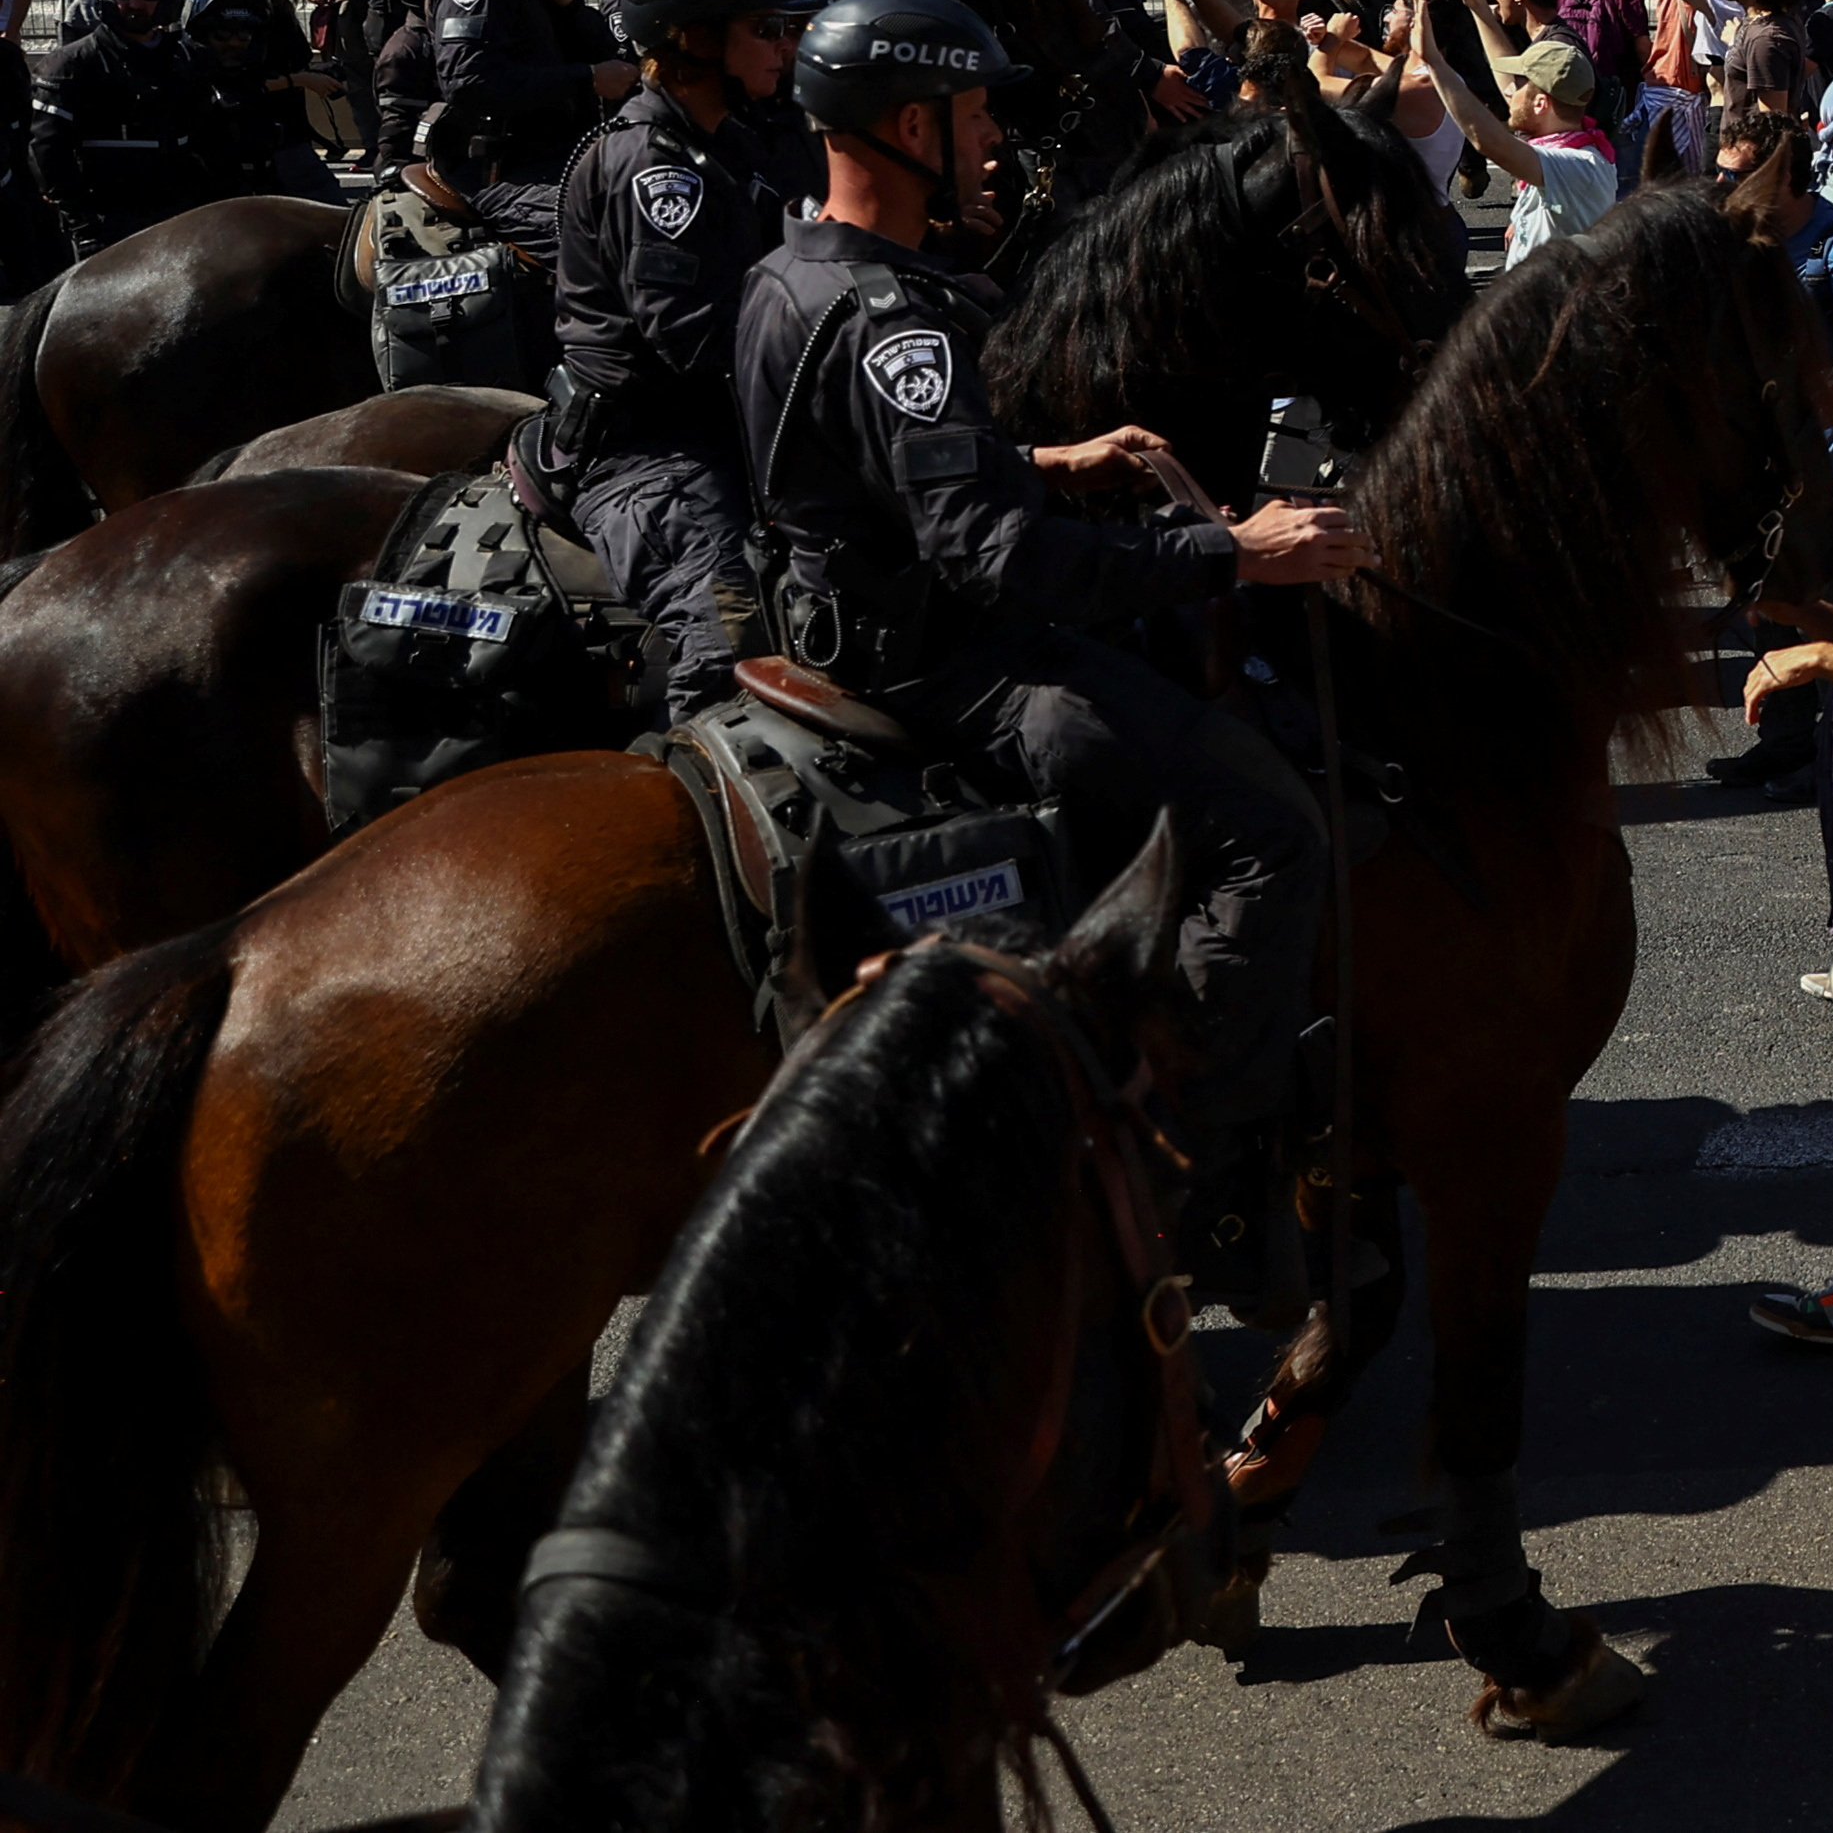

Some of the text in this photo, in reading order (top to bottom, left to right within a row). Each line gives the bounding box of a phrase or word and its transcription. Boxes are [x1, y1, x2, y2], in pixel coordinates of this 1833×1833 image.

[869, 38, 981, 71] POLICE
[395, 273, 481, 302] משטרה
[871, 344, 901, 368] ישראל
[374, 596, 503, 634] משטרה
[888, 873, 1010, 926] משטר
